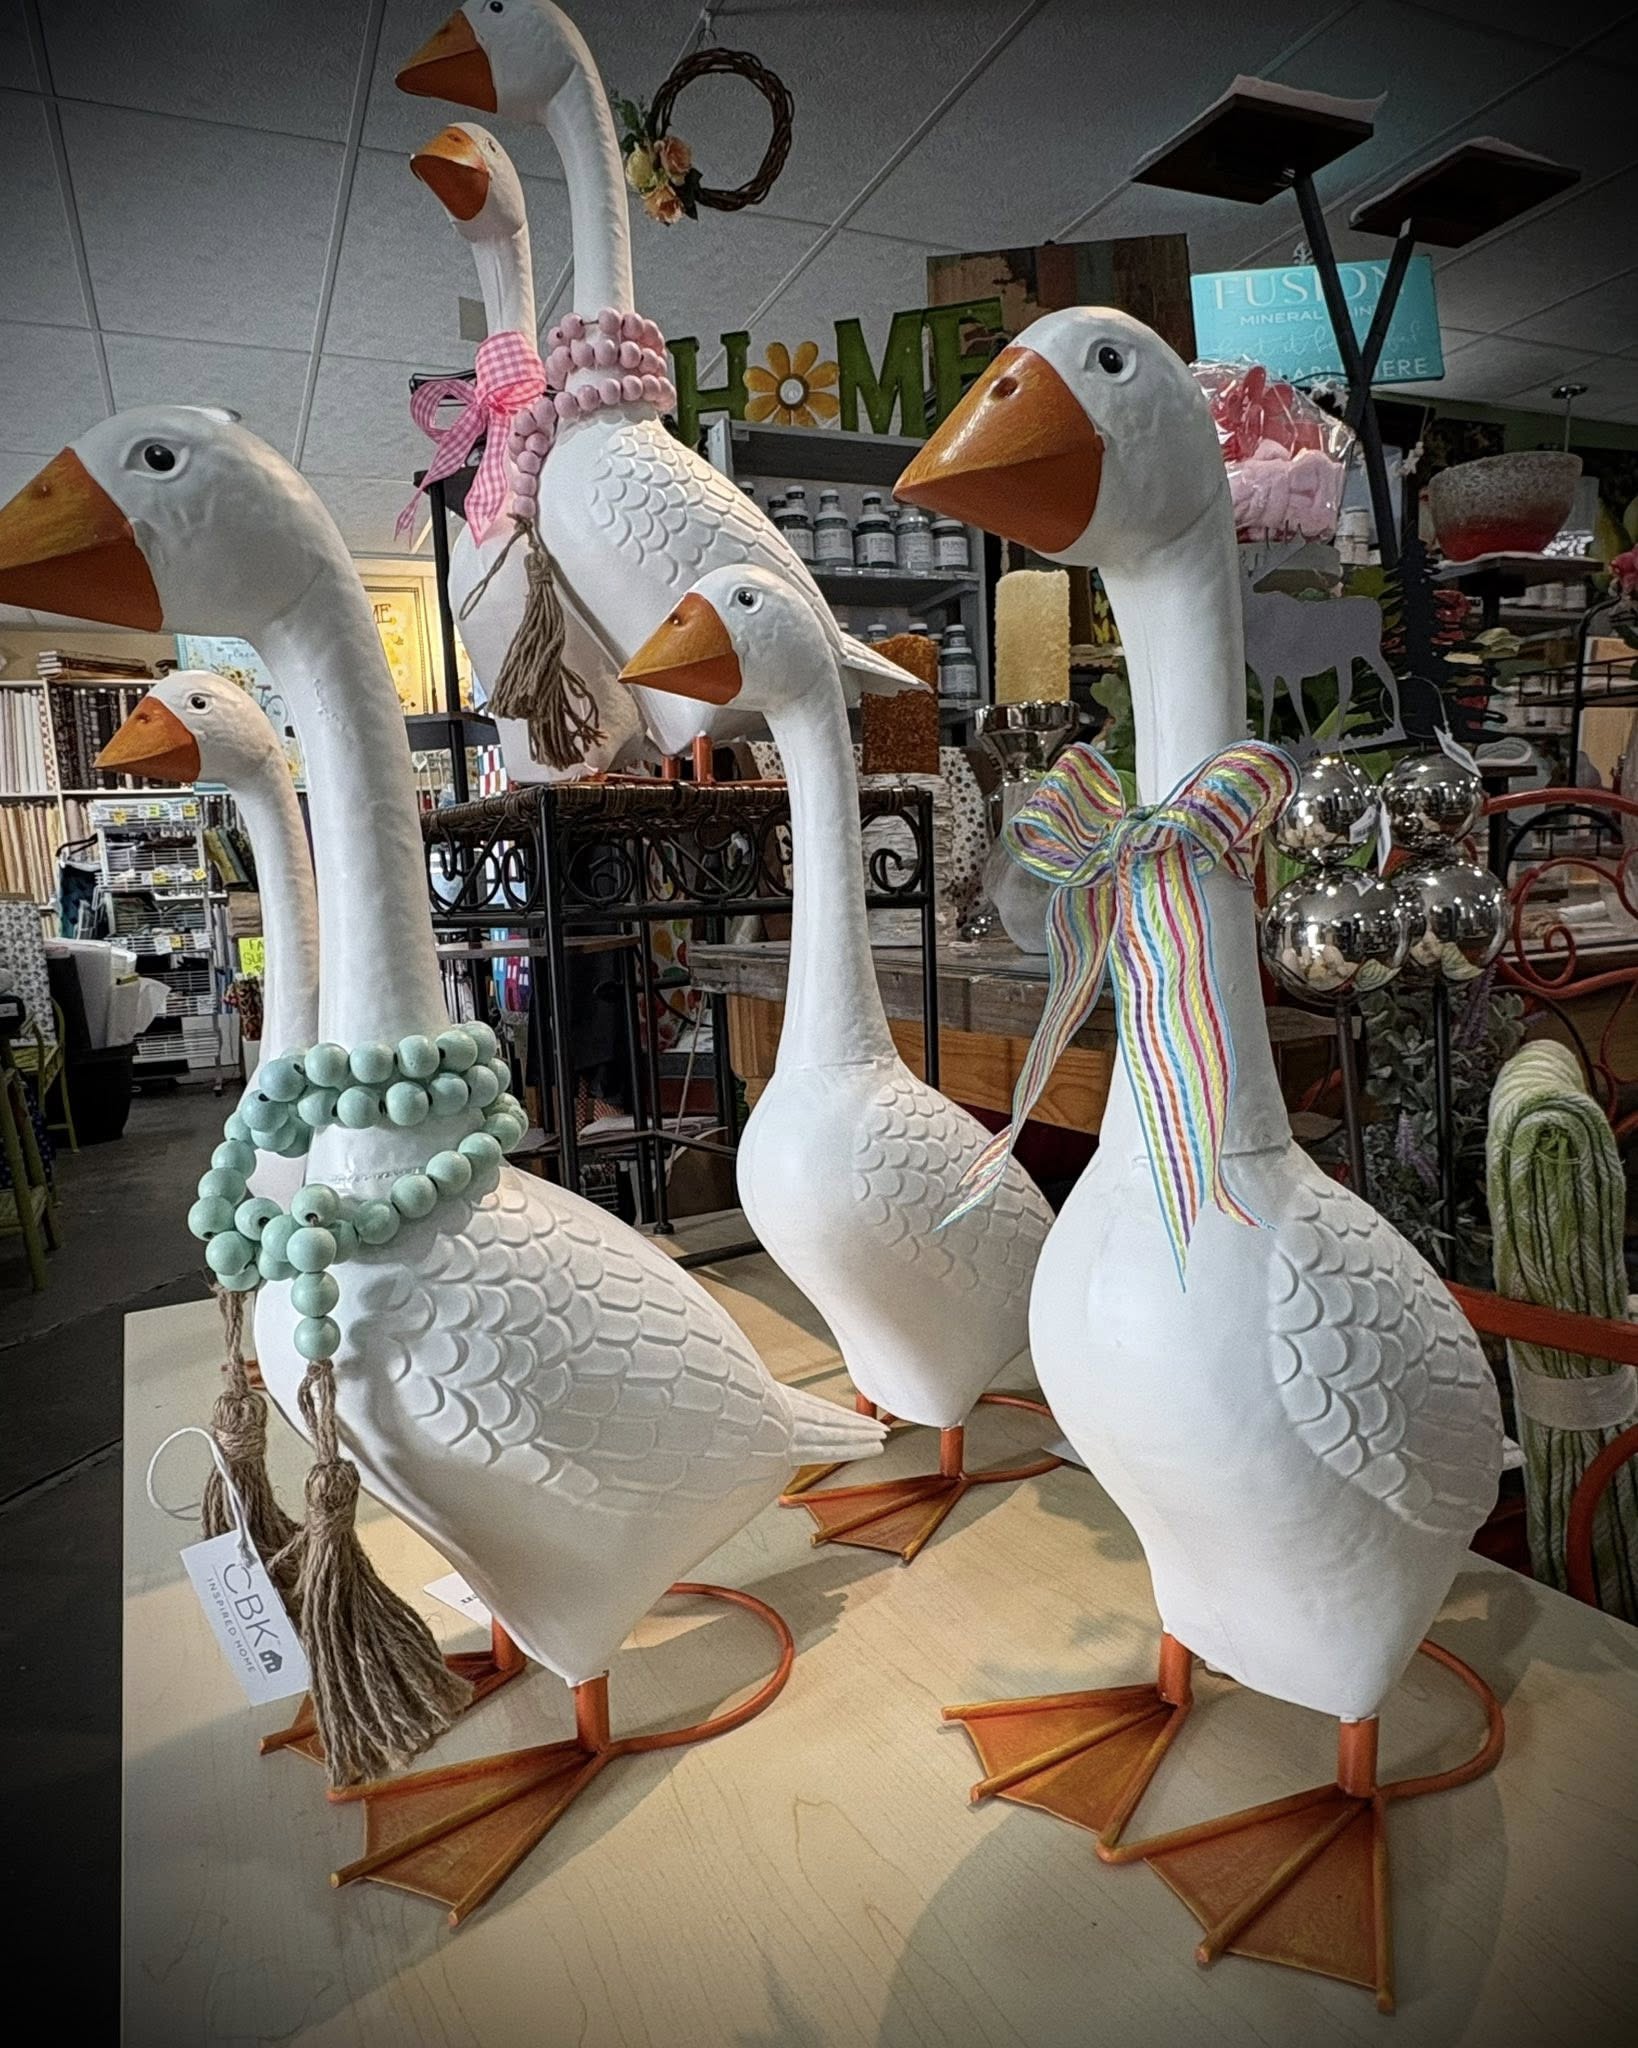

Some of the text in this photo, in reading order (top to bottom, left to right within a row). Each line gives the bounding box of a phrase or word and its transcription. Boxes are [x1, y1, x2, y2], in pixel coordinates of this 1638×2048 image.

[1239, 309, 1324, 326] MINERAL
[207, 1577, 256, 1673] INSPIRED HOME
[223, 1563, 279, 1648] CBK
